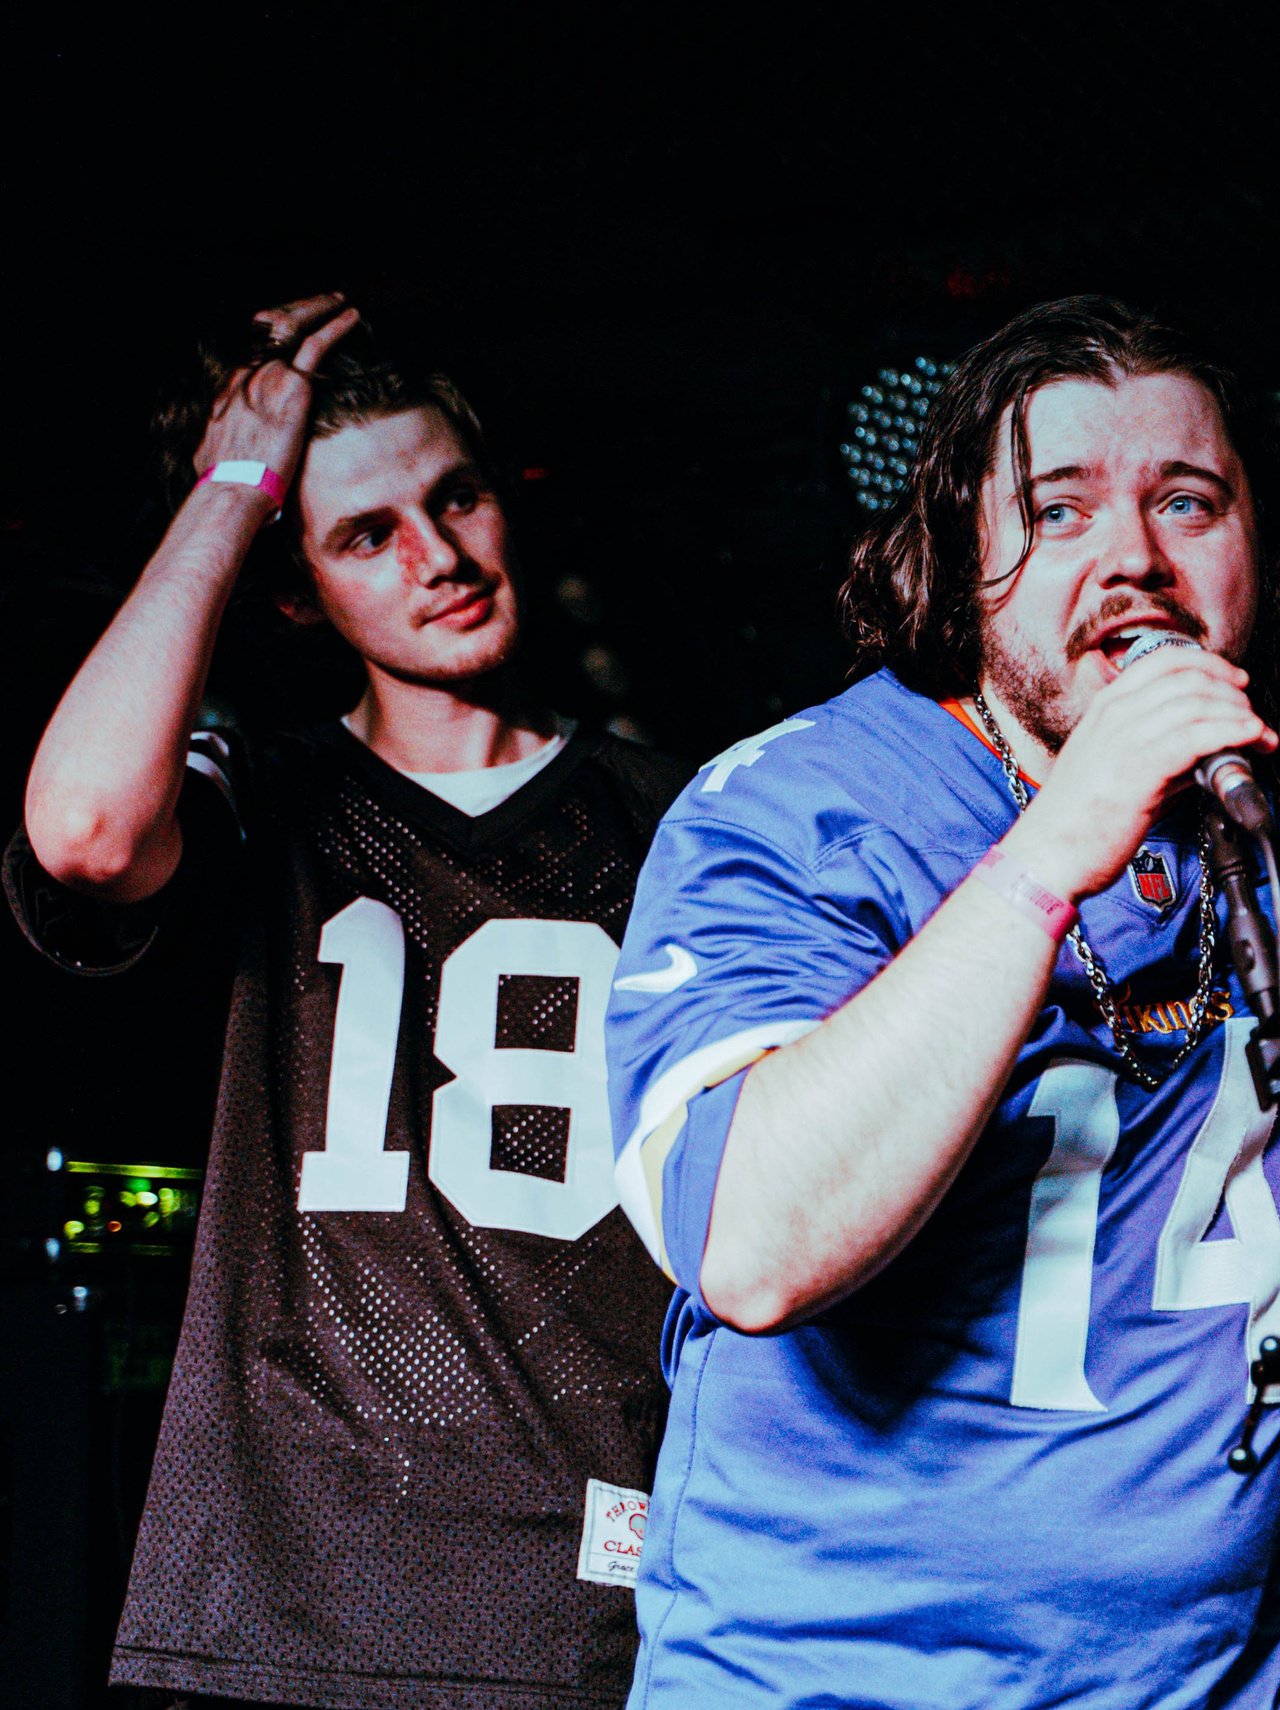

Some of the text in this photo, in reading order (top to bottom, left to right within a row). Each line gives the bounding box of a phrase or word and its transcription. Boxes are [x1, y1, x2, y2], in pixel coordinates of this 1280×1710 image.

[698, 718, 817, 793] 4
[1138, 872, 1172, 901] NFL
[297, 896, 622, 1241] 18
[606, 1501, 647, 1522] THROW
[605, 1541, 642, 1557] CLAS
